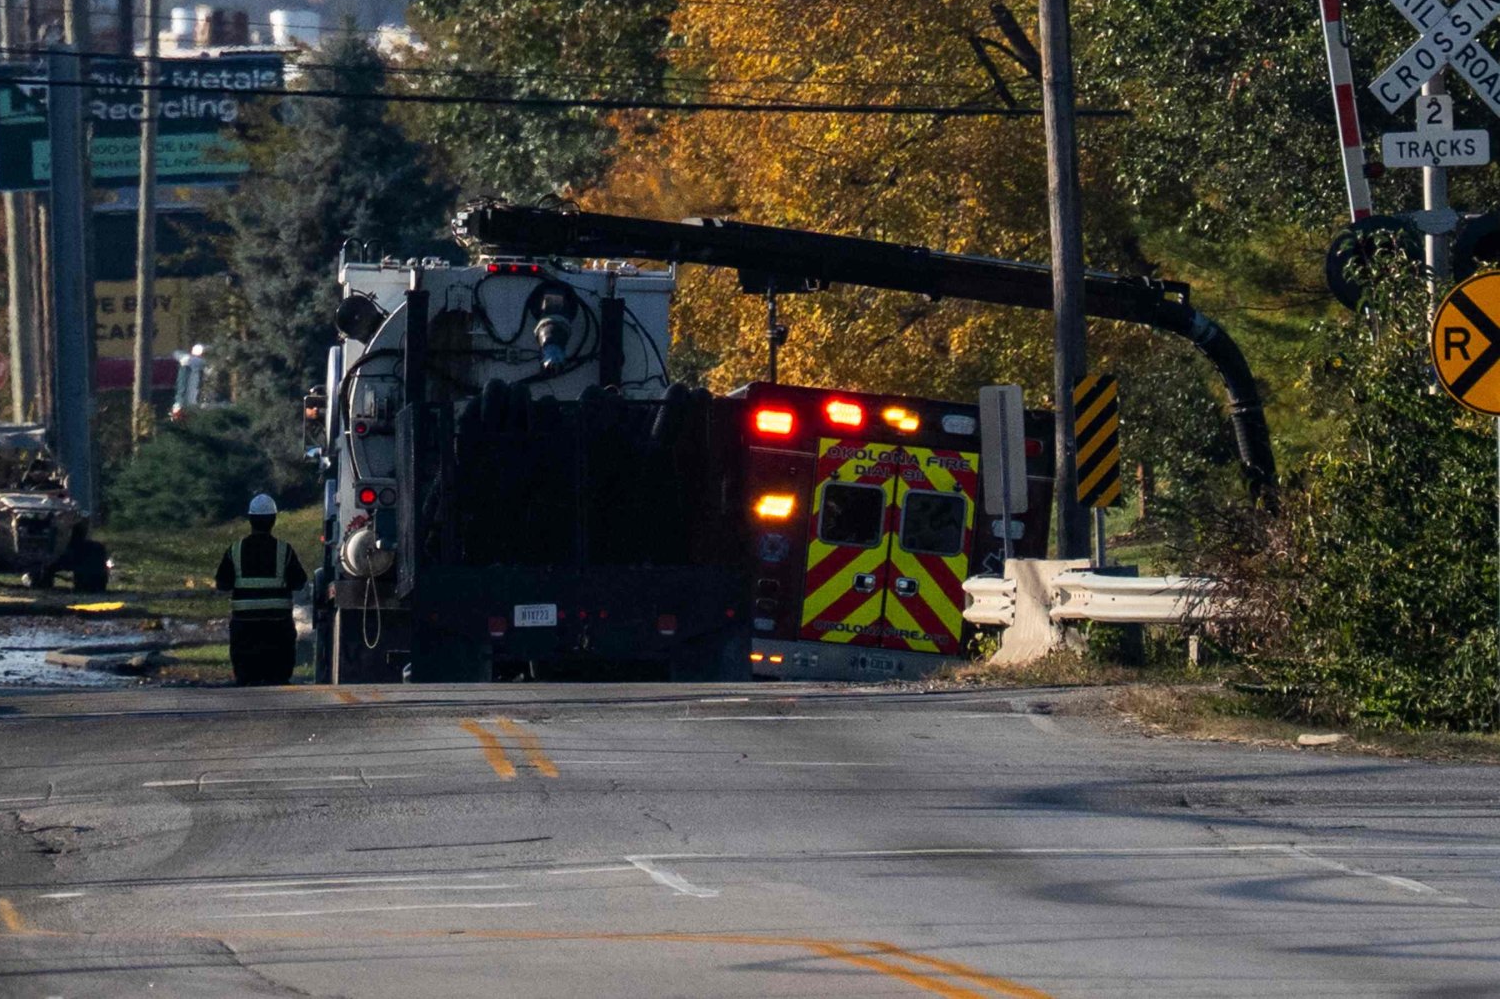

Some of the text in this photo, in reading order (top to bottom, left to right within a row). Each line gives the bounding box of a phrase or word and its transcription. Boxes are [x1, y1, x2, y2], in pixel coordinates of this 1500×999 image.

[172, 68, 277, 91] Metals
[1426, 102, 1443, 125] 2
[1395, 137, 1476, 159] TRACKS
[1444, 326, 1472, 361] R
[827, 445, 972, 472] OKOLONA FIRE
[853, 463, 926, 481] DIAL 911
